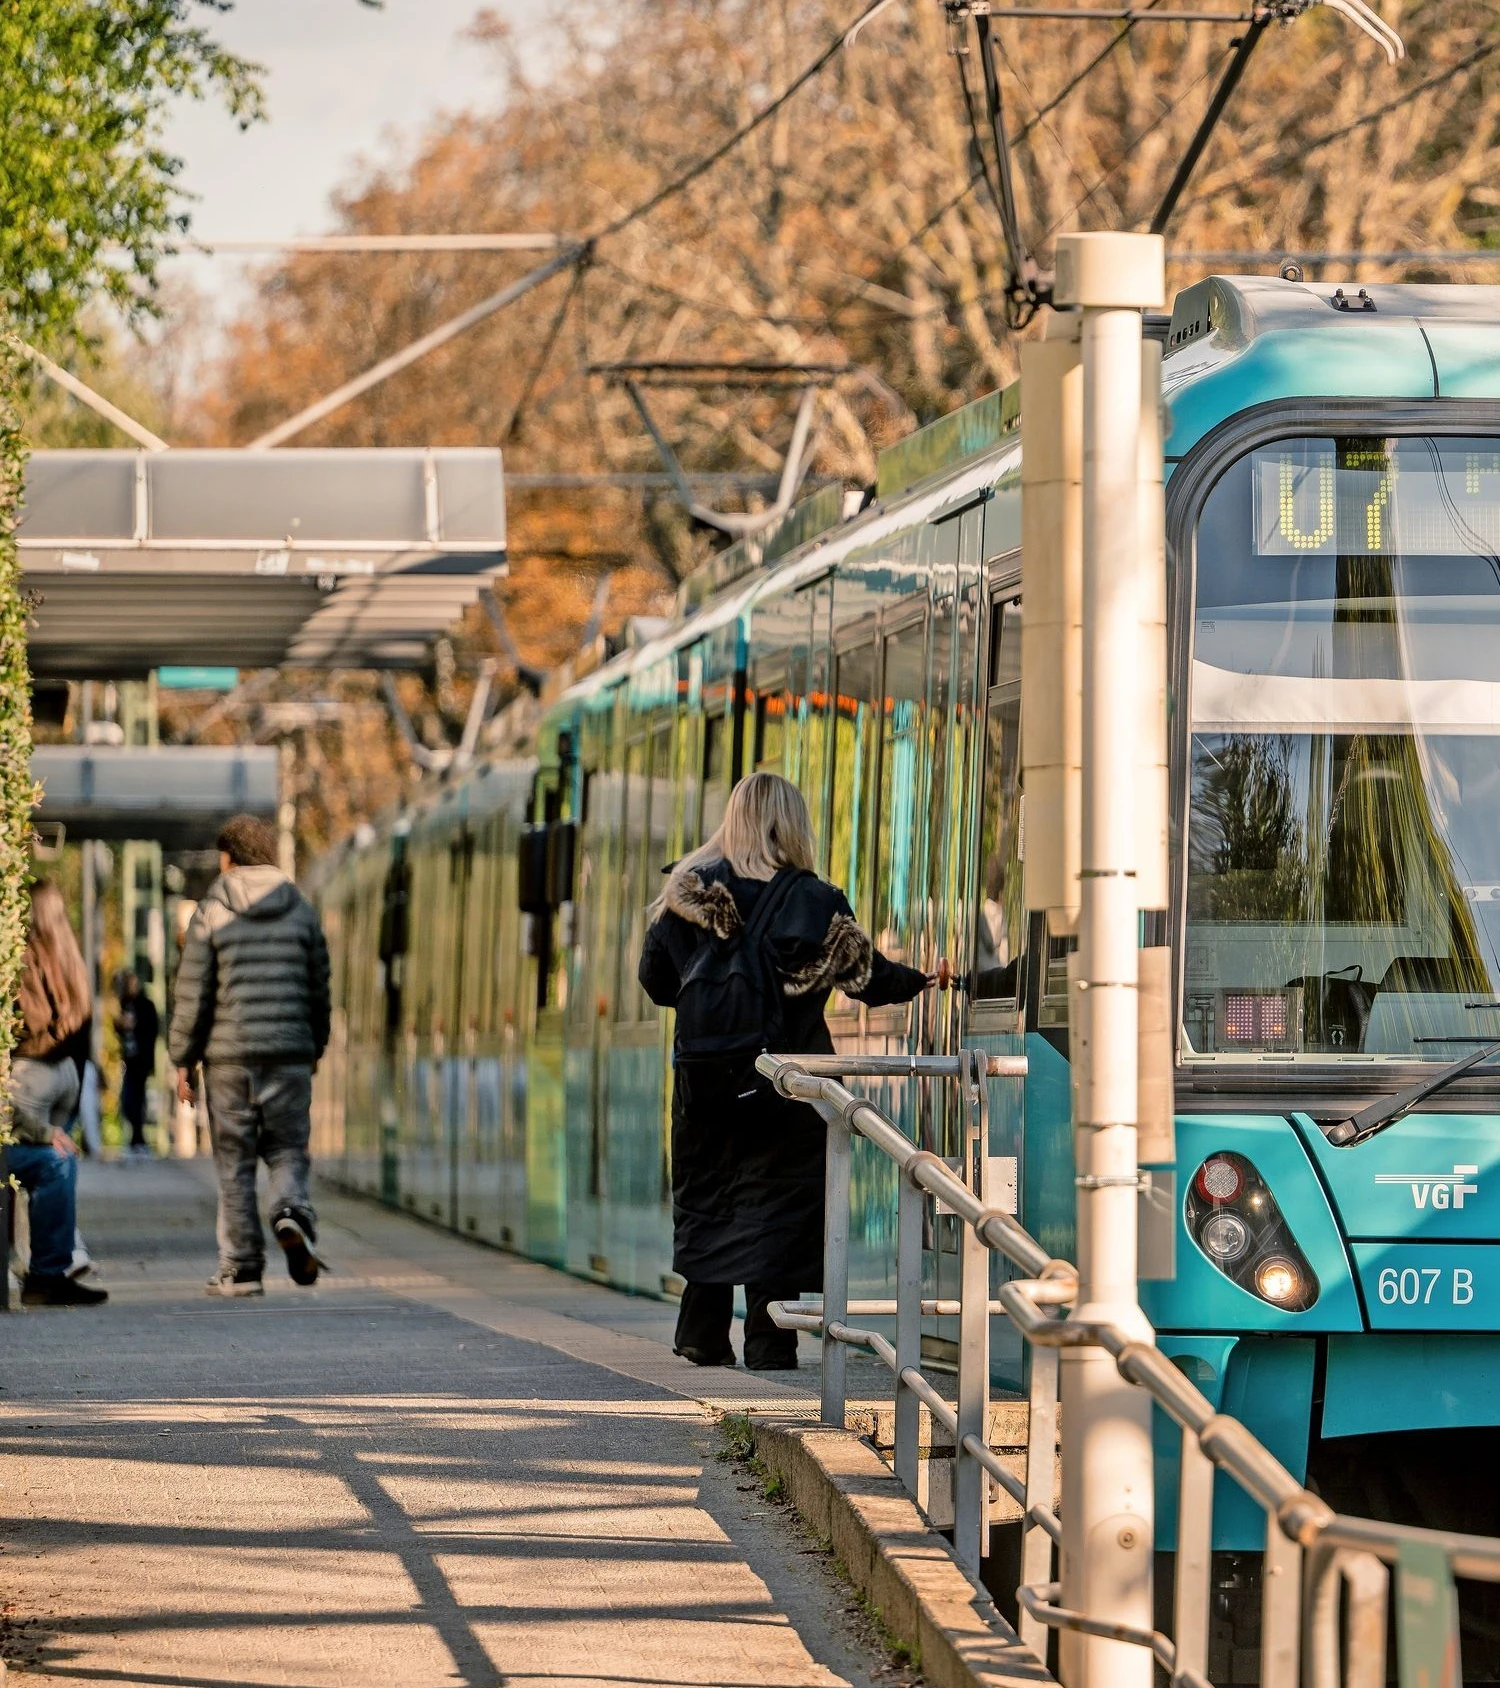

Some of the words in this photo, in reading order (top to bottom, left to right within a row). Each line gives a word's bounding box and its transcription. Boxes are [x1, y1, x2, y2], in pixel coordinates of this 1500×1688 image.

[1279, 452, 1399, 549] U7
[1410, 1164, 1479, 1210] VGF
[1378, 1267, 1442, 1305] 607
[1452, 1268, 1474, 1305] B
